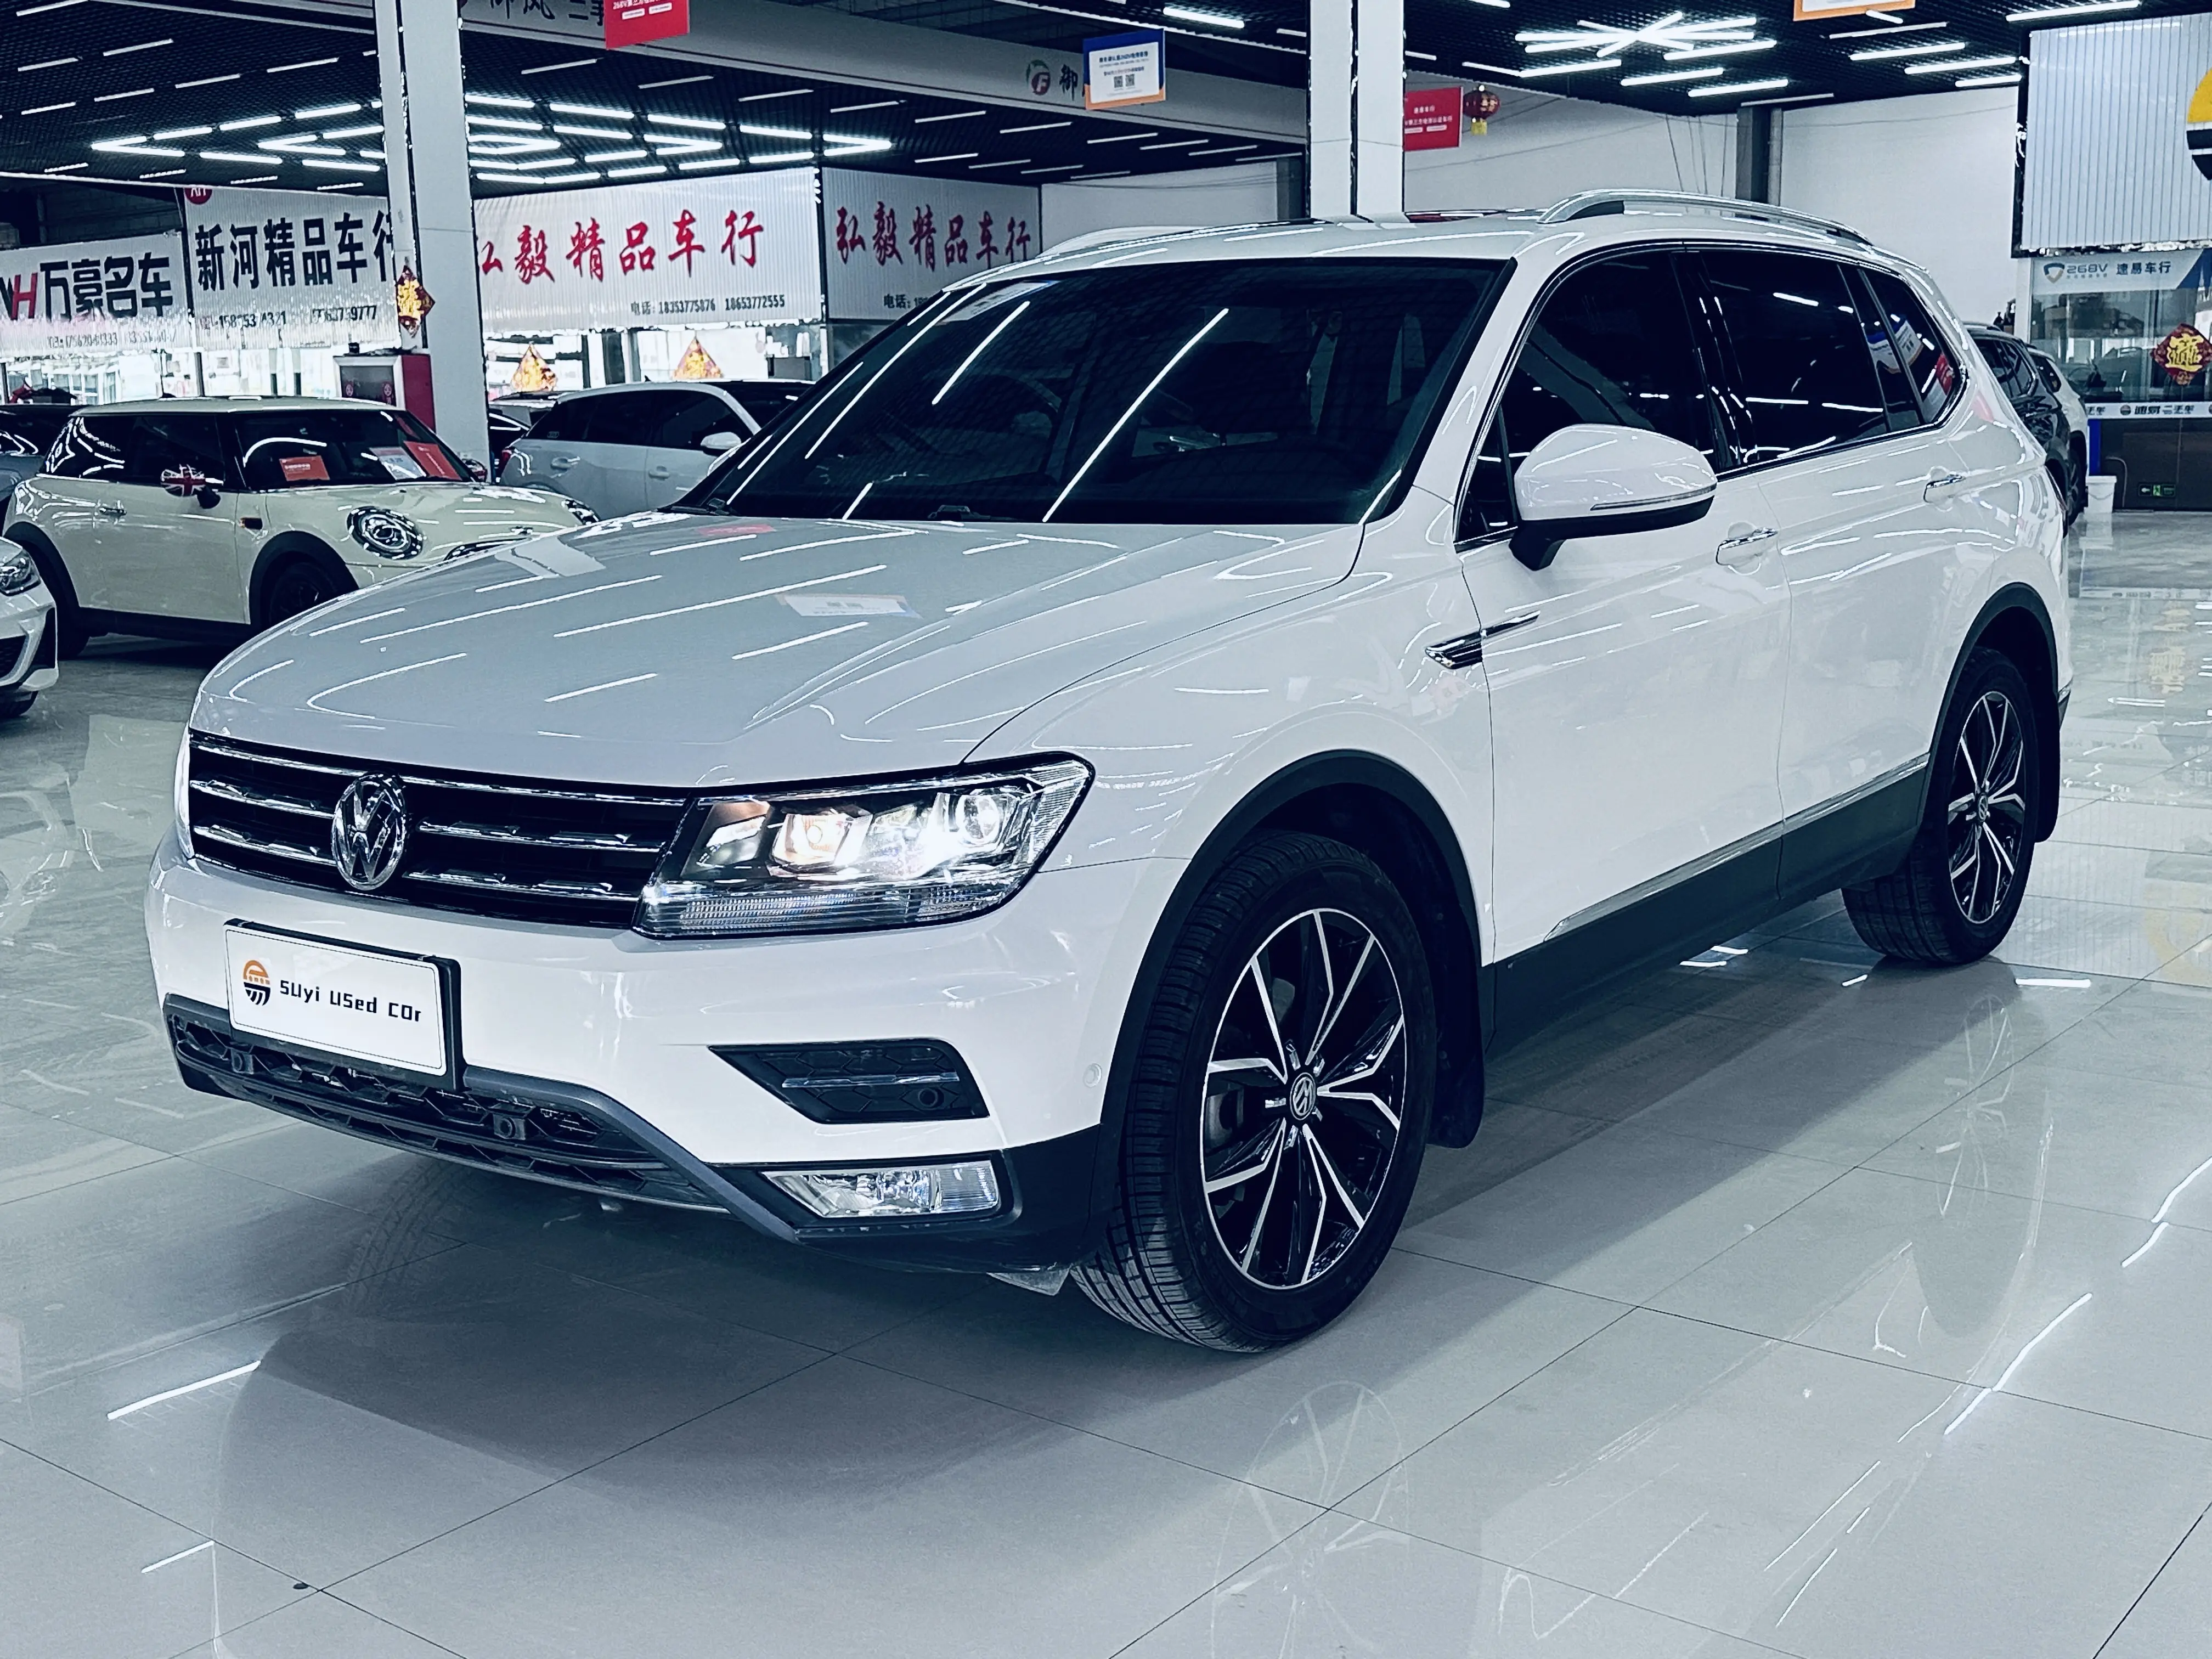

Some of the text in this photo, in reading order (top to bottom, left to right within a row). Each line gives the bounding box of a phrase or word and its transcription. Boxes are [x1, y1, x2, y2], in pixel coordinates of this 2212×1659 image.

[837, 201, 1031, 272] 弘毅精品车行
[40, 252, 173, 322] 万豪名车
